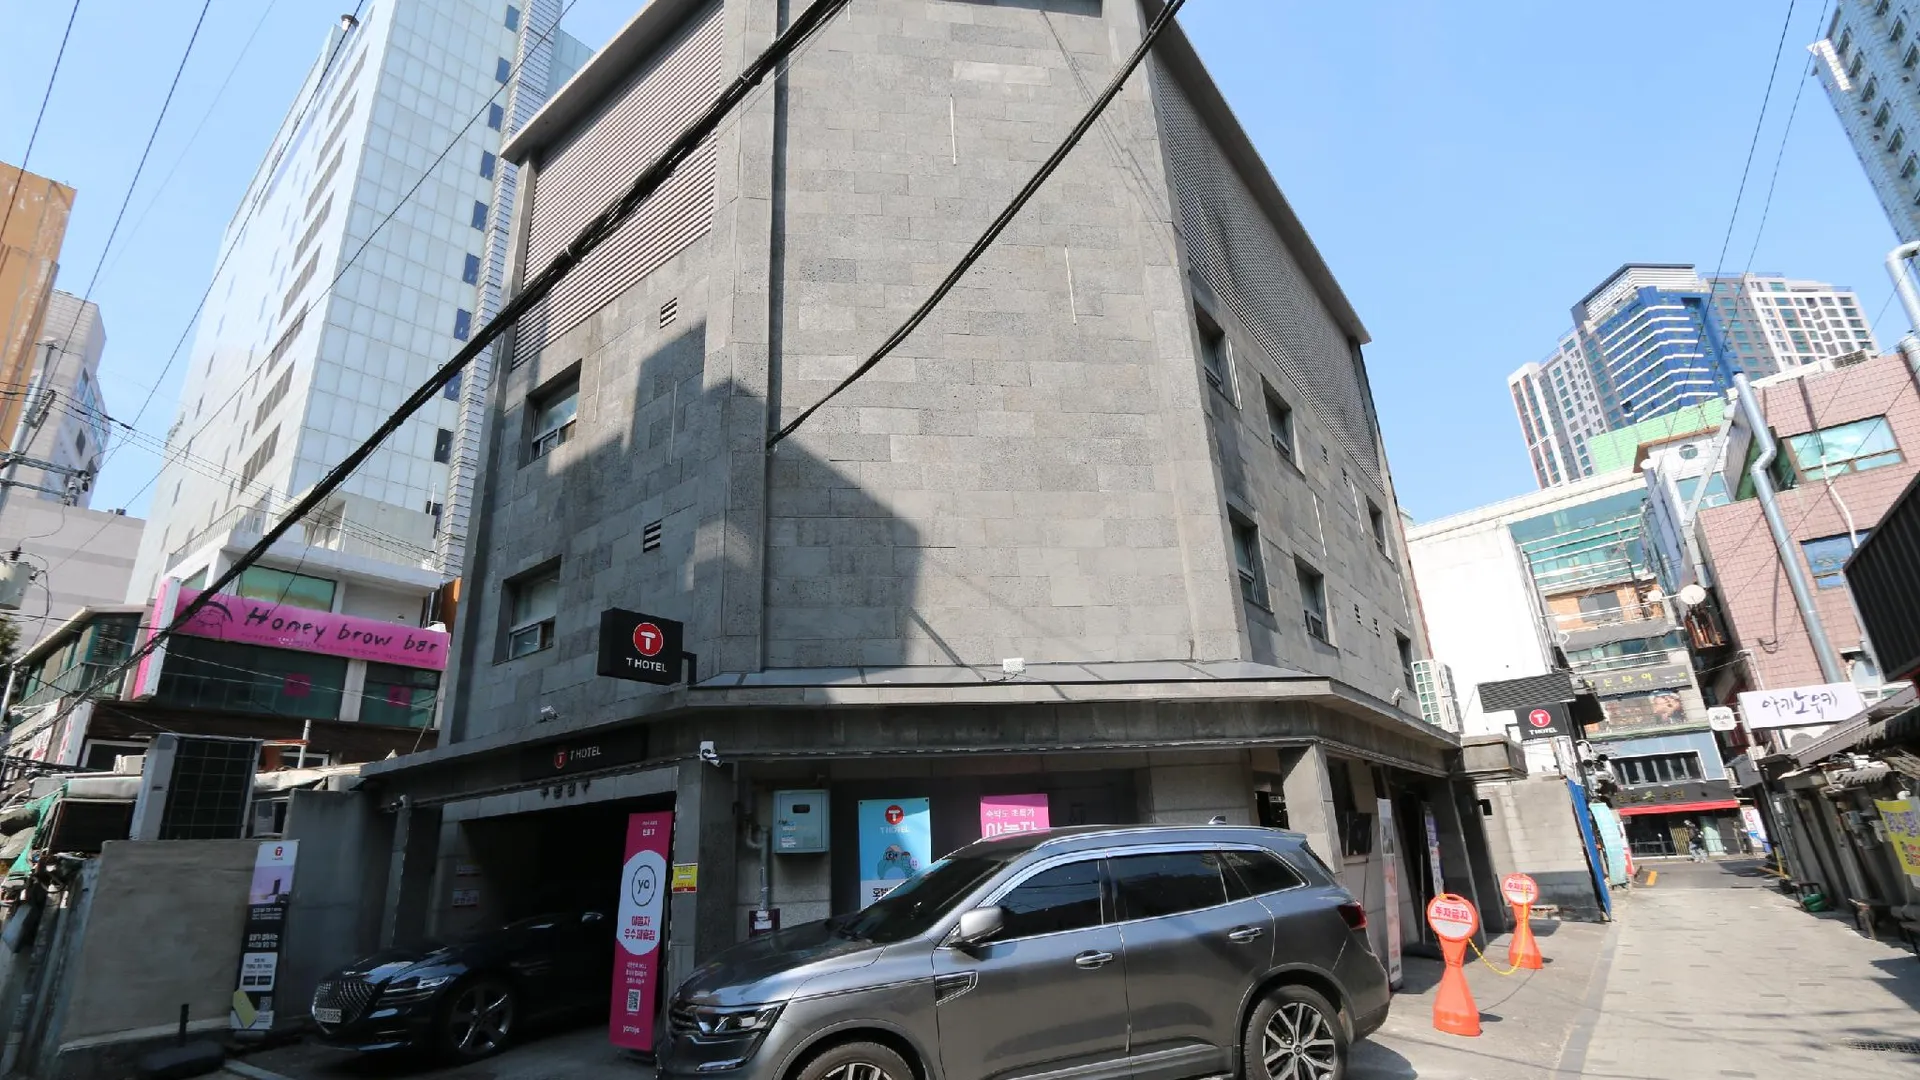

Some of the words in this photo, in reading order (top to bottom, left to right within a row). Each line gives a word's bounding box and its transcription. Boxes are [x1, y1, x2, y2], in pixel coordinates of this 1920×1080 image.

[244, 606, 327, 643] Honey
[337, 623, 395, 647] brow
[626, 657, 633, 666] T
[634, 659, 667, 673] HOTEL
[576, 746, 602, 758] HOTEL
[1435, 906, 1469, 920] 주차금지
